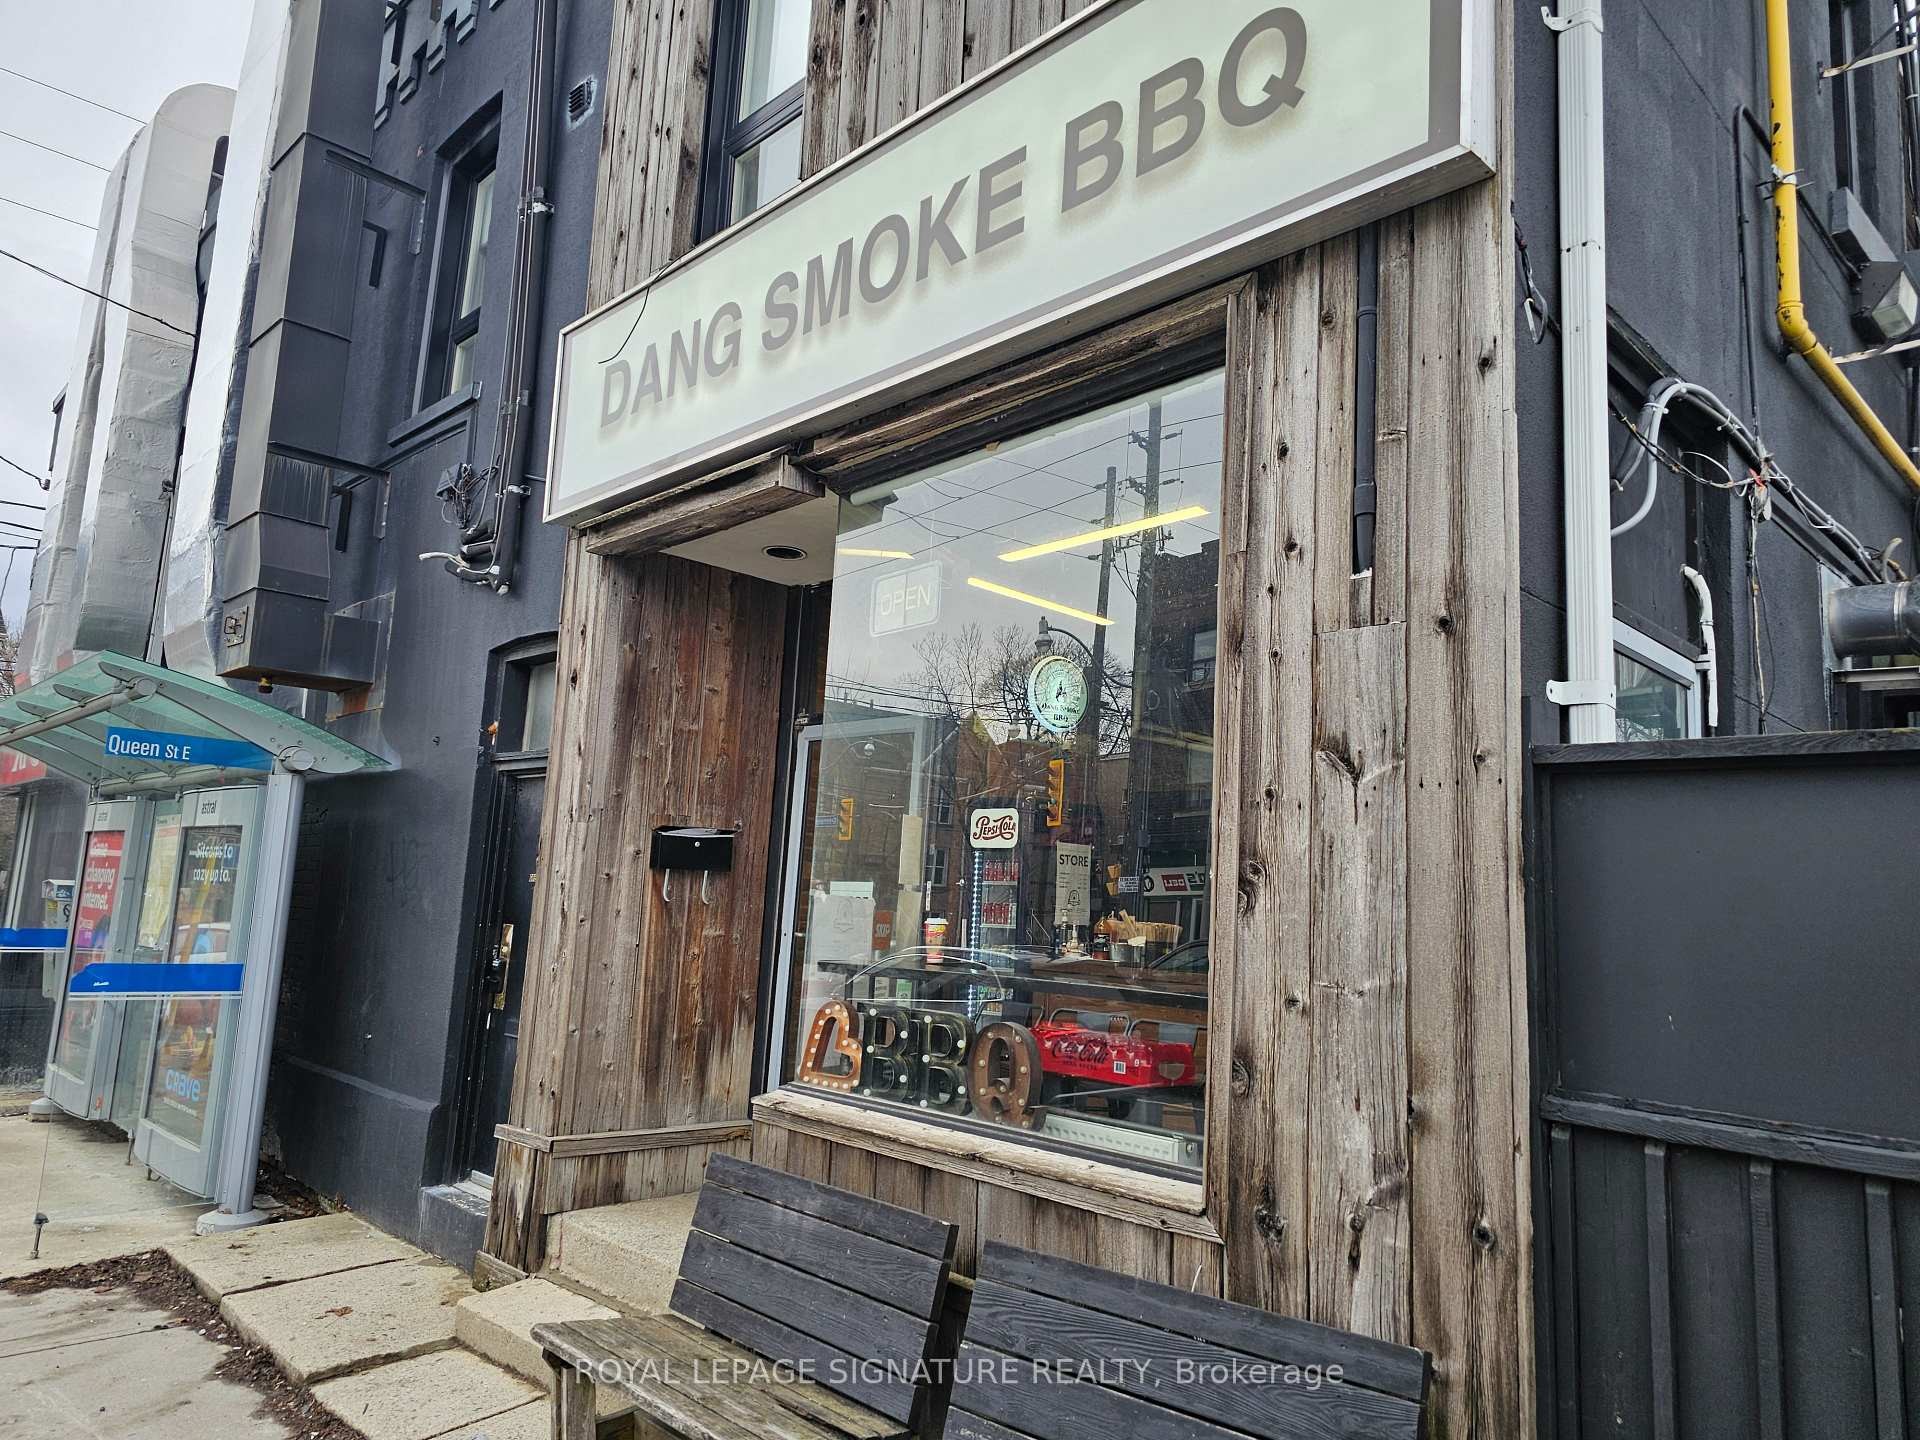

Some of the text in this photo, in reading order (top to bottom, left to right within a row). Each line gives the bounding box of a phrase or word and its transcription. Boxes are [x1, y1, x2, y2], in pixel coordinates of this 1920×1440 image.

[600, 7, 1308, 428] DANG SMOKE BBQ
[880, 583, 931, 616] OPEN
[108, 734, 192, 761] Queen St E
[201, 801, 217, 815] astral
[223, 842, 234, 859] to
[1059, 854, 1089, 868] STORE
